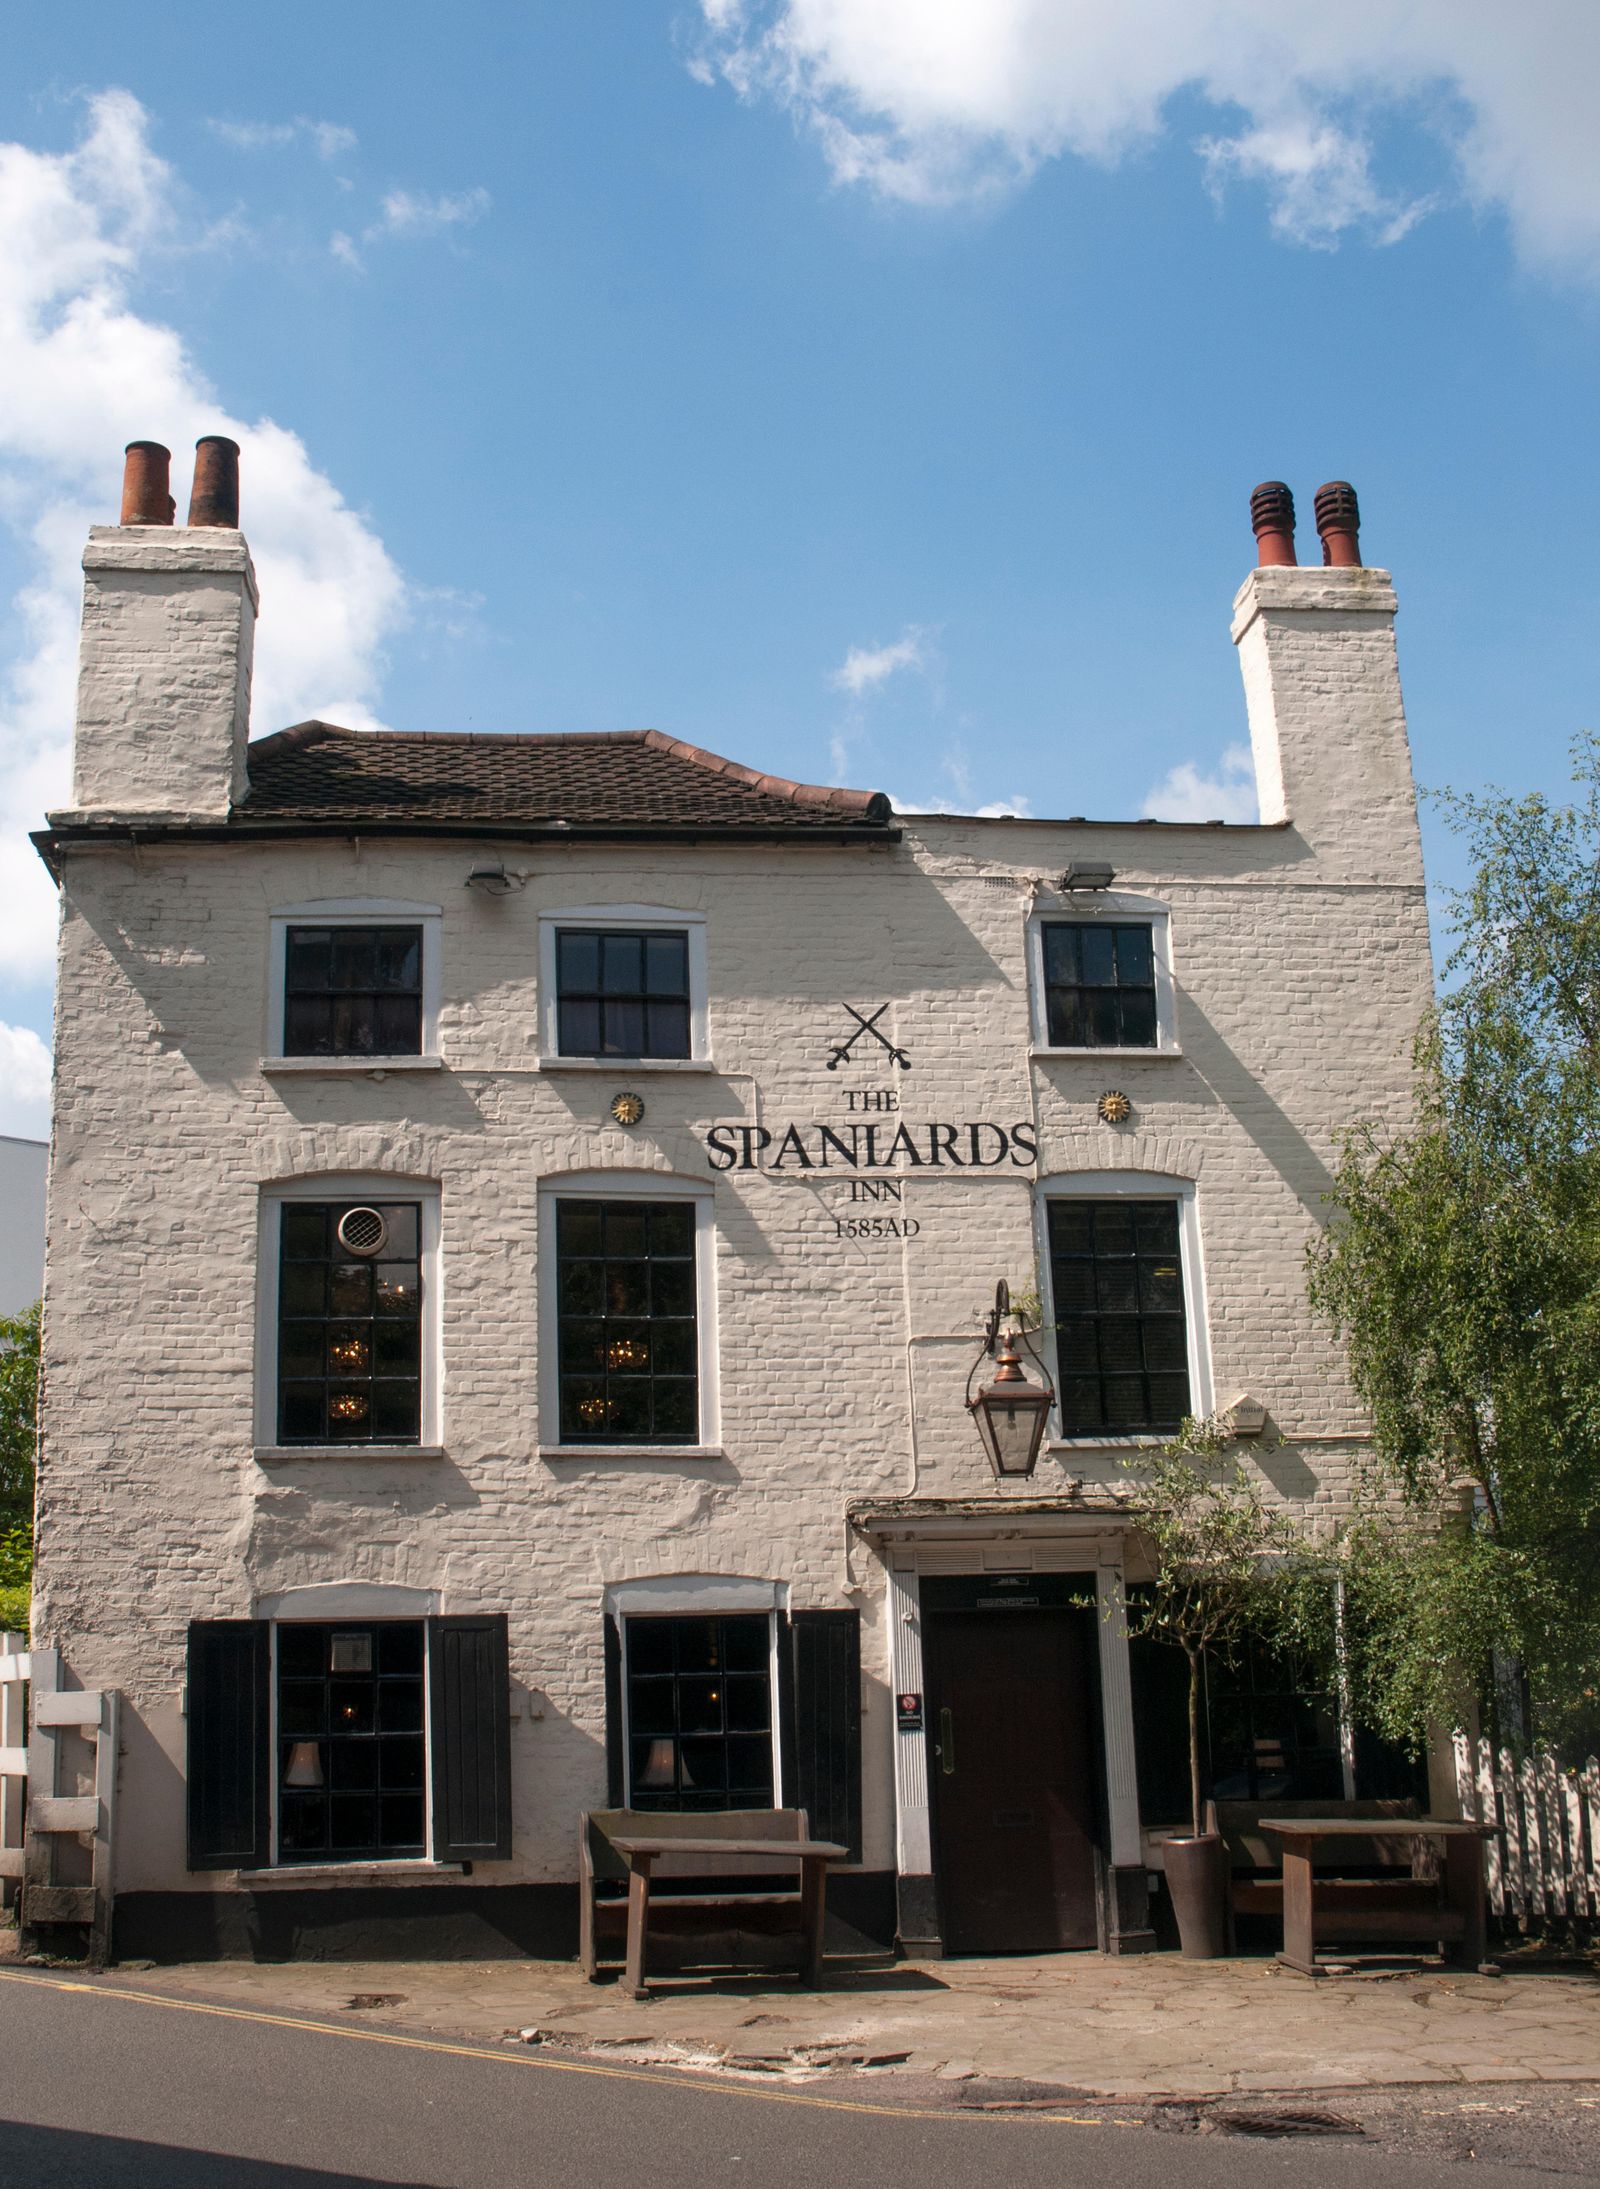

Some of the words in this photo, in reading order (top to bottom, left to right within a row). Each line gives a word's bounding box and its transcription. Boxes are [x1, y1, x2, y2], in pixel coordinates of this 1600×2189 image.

[842, 1090, 900, 1112] THE
[707, 1122, 1039, 1171] SPANIARDS
[848, 1180, 903, 1202] INN
[834, 1217, 921, 1239] 1585AD
